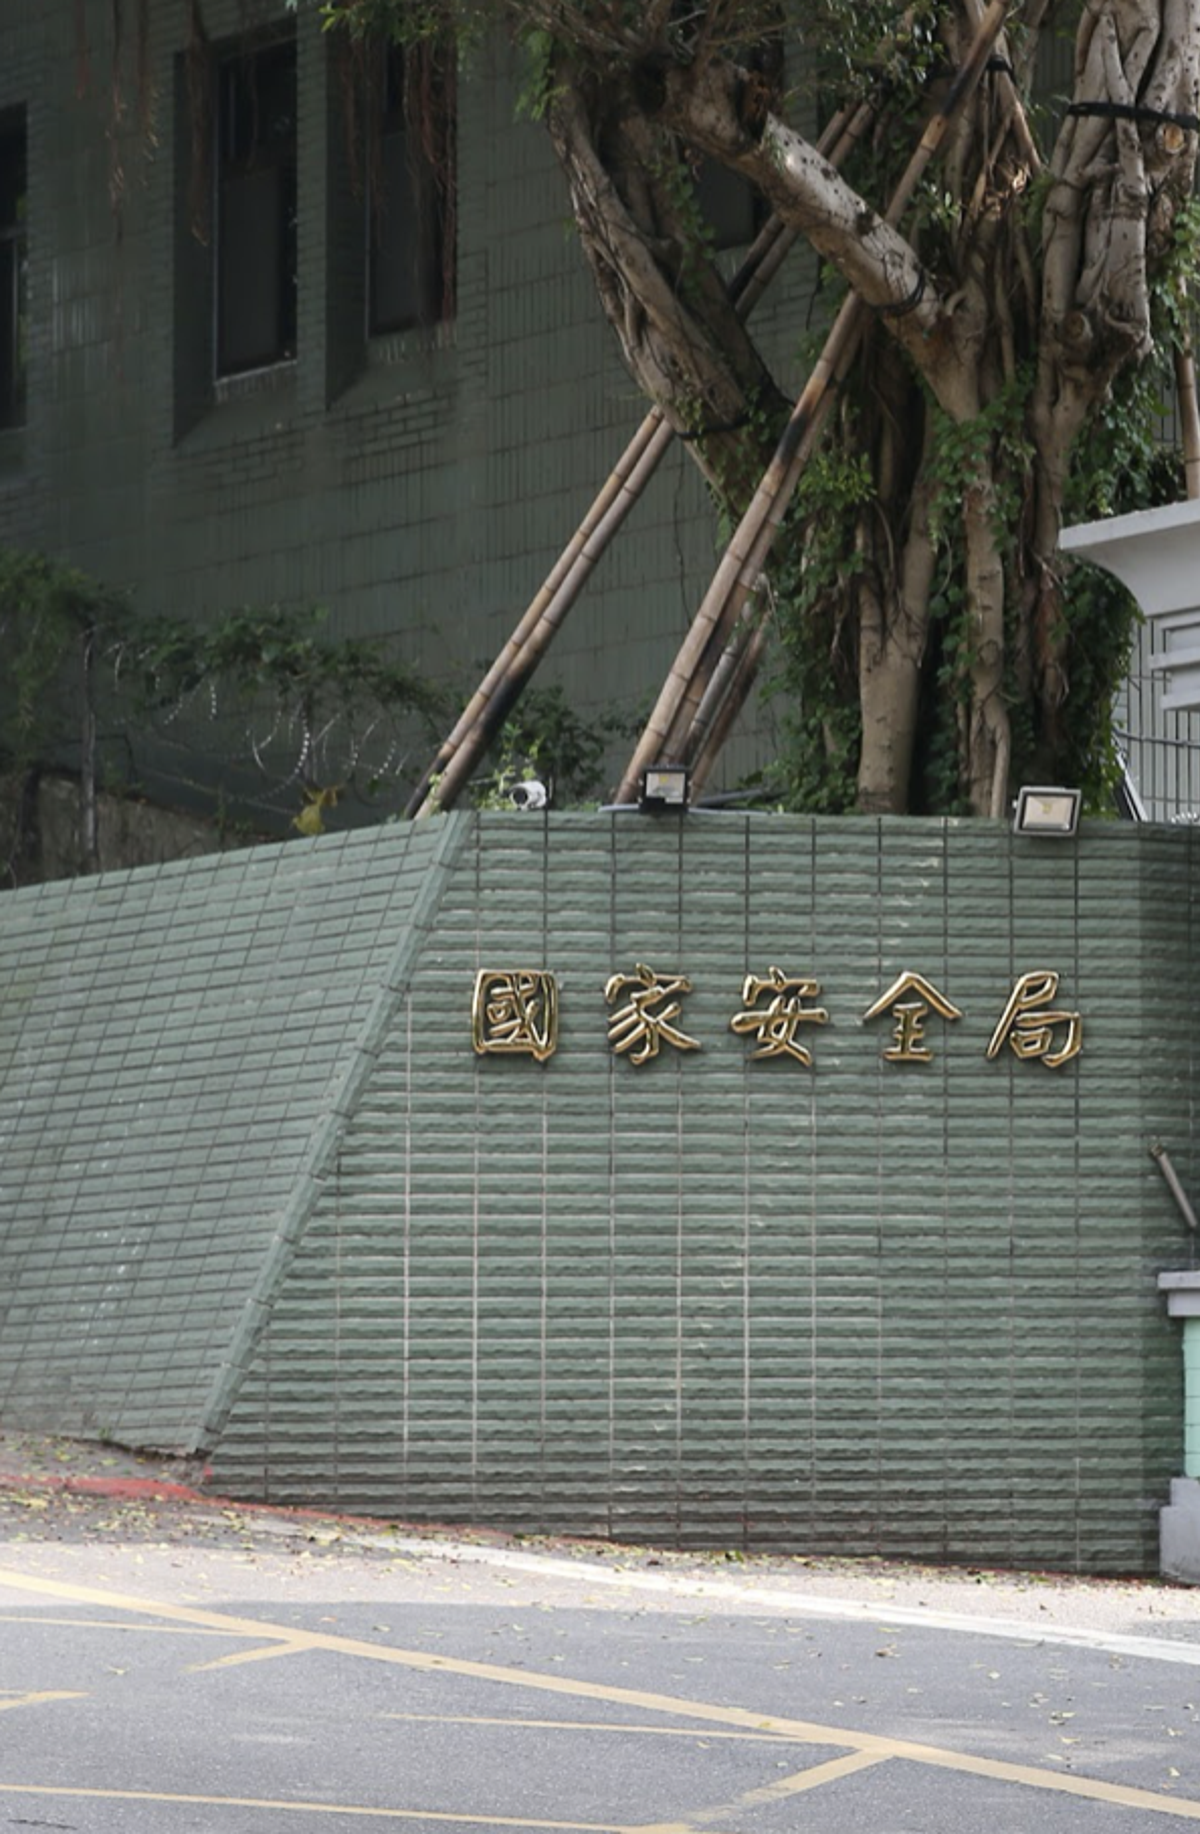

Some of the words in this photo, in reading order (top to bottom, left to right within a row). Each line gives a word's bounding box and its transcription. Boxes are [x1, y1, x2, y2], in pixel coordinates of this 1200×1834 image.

[472, 964, 1082, 1067] 國家安全局
